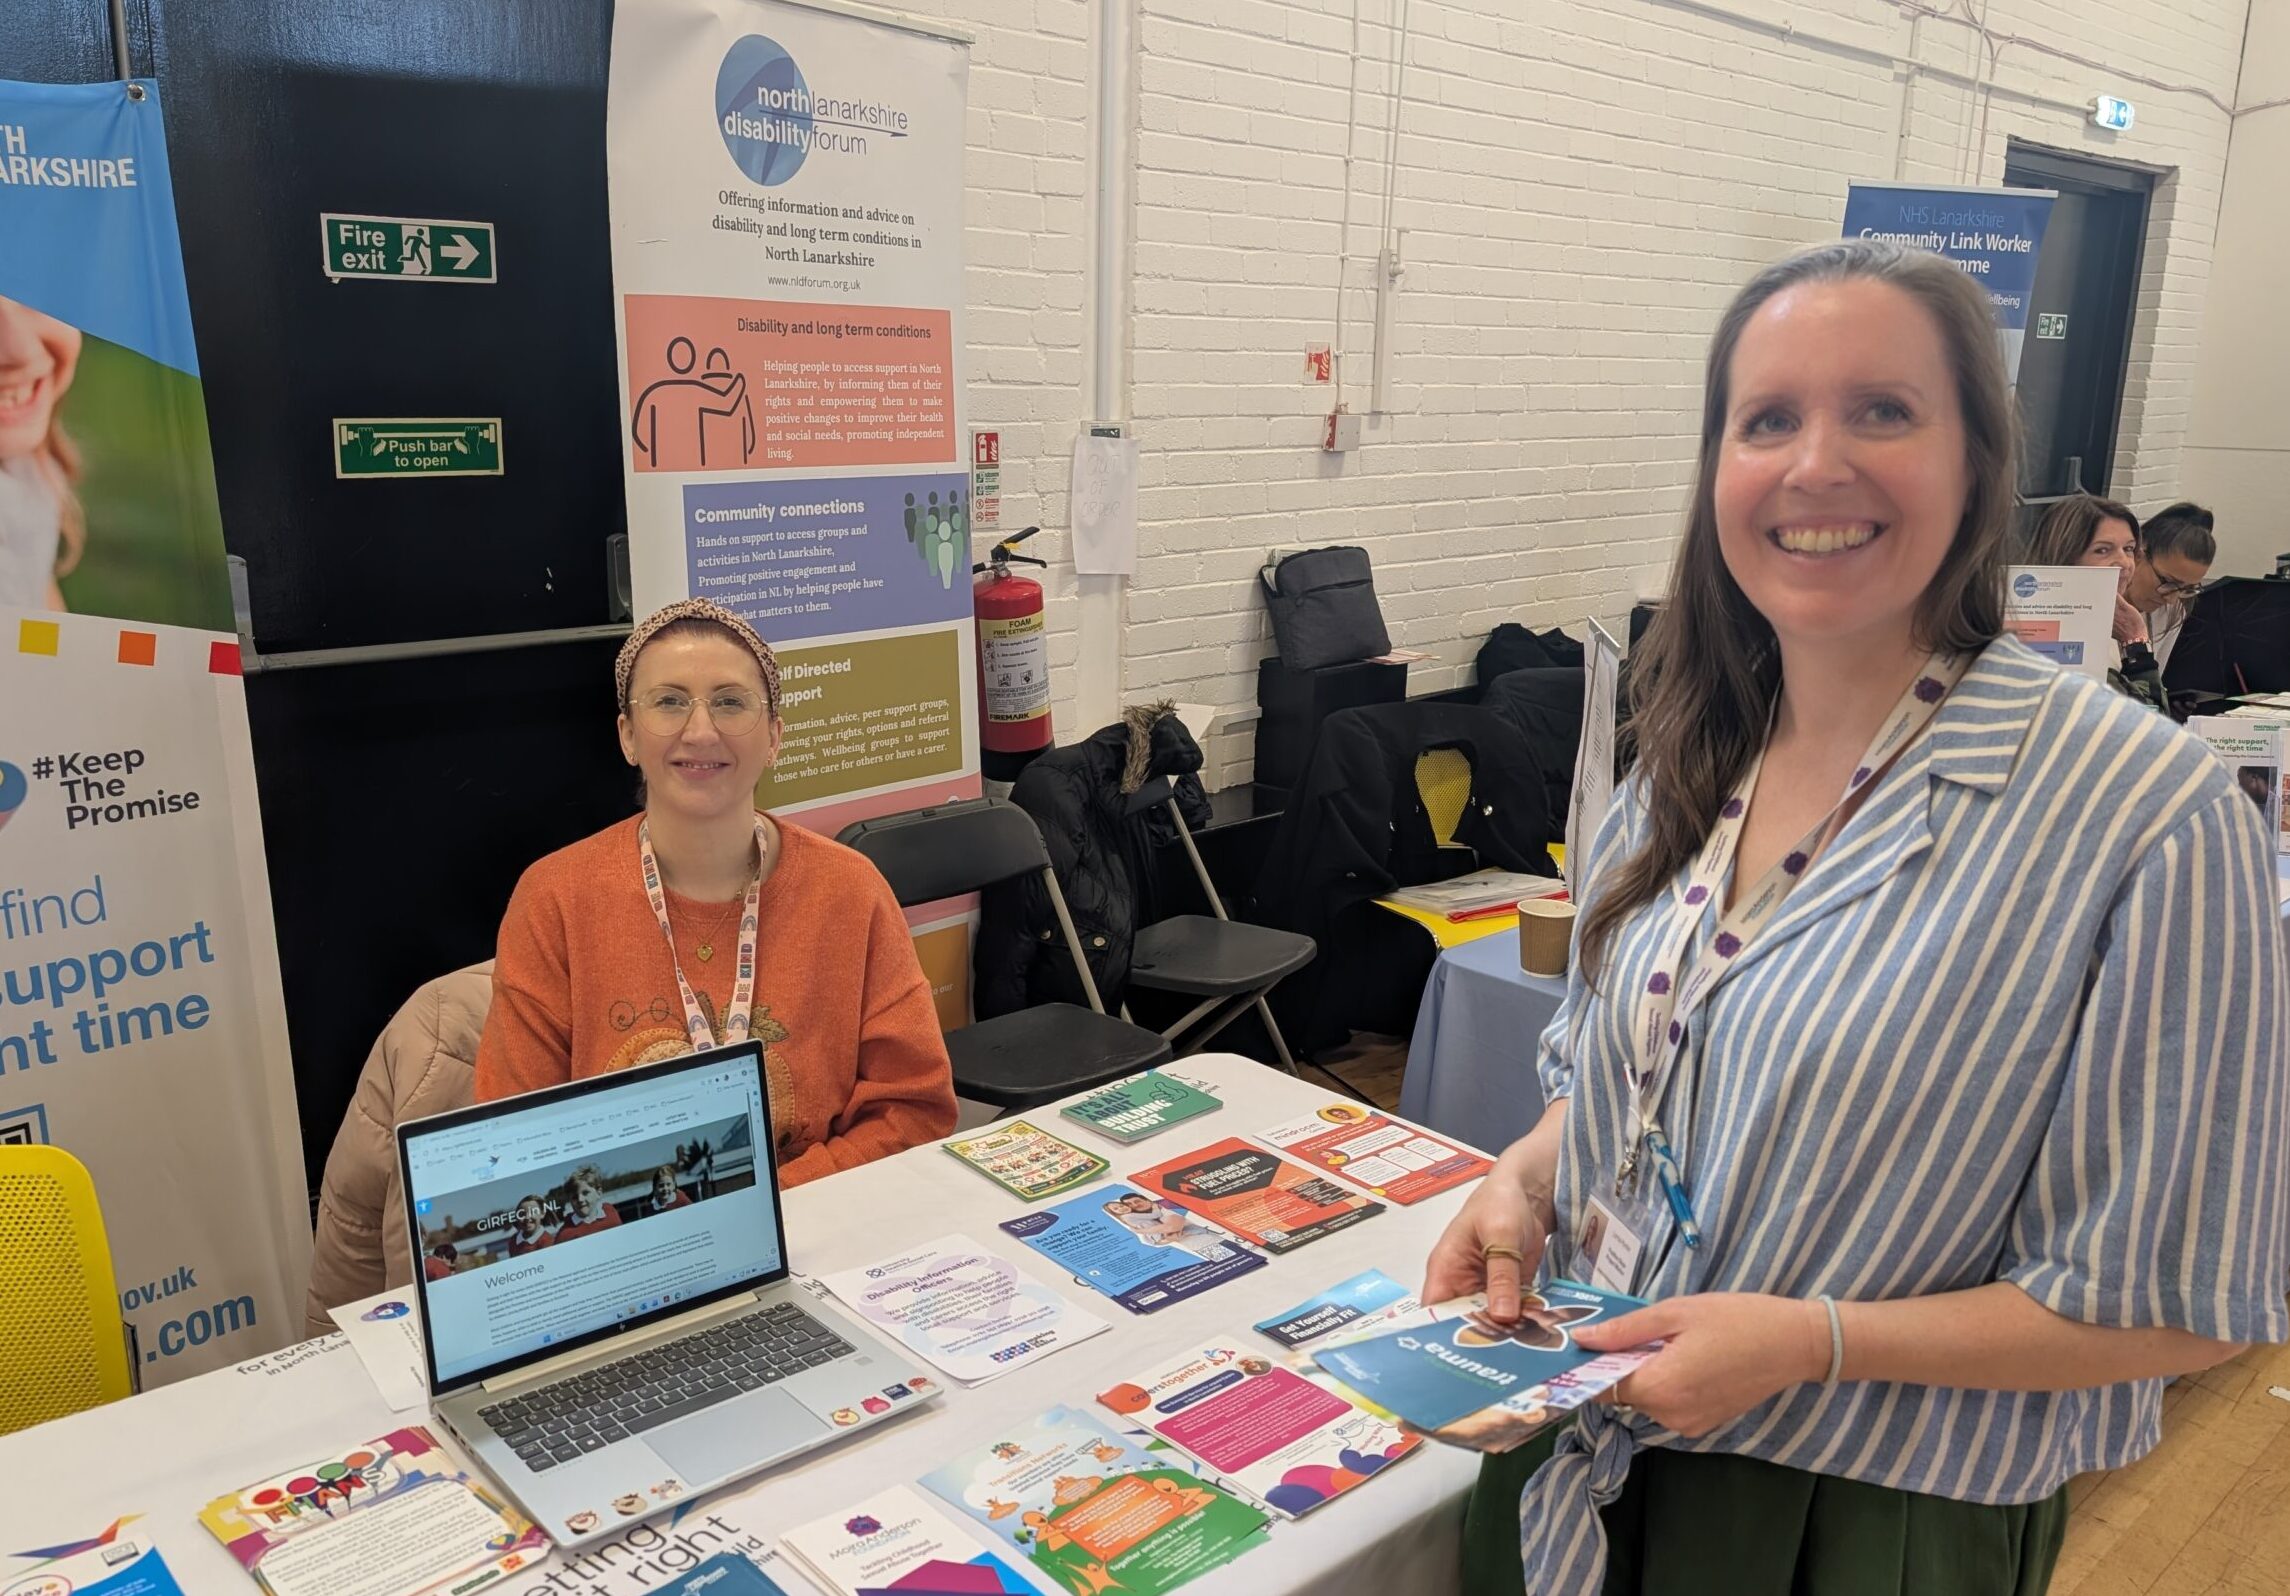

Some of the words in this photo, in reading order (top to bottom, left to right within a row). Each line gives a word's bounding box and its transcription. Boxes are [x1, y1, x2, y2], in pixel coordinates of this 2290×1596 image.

[0, 125, 27, 155] H
[719, 190, 765, 213] Offering
[767, 197, 838, 218] information
[842, 205, 863, 220] and
[866, 208, 899, 224] advice
[902, 214, 914, 225] on
[1900, 206, 1929, 225] NHS
[1932, 208, 2004, 228] Lanarkshire
[339, 224, 385, 246] Fire
[712, 215, 763, 238] disability
[766, 223, 787, 238] and
[790, 223, 816, 243] long
[820, 229, 849, 242] term
[852, 230, 909, 248] conditions
[911, 236, 922, 249] in
[1860, 228, 1947, 251] Community
[1950, 232, 1982, 249] Link
[1985, 233, 2031, 253] Worker
[342, 250, 386, 270] exit
[765, 246, 799, 262] North
[803, 249, 875, 267] Lanarkshire
[768, 276, 861, 292] www.nldforum.org.uk
[738, 318, 788, 338] Disability
[791, 321, 813, 335] and
[816, 322, 842, 339] long
[845, 322, 873, 337] term
[876, 323, 931, 338] conditions
[764, 361, 798, 374] Helping
[800, 362, 828, 375] people
[832, 364, 842, 373] to
[844, 364, 873, 373] access
[875, 363, 907, 376] support
[909, 363, 917, 372] in
[919, 363, 941, 374] North
[764, 378, 820, 392] Lanarkshire,
[824, 380, 834, 392] by
[839, 378, 884, 392] informing
[888, 379, 909, 390] them
[912, 379, 921, 390] of
[923, 380, 942, 390] their
[389, 440, 425, 453] Push
[429, 440, 453, 452] bar
[767, 431, 782, 441] and
[786, 430, 811, 441] social
[815, 430, 843, 442] needs,
[847, 428, 893, 443] promoting
[896, 428, 944, 441] independent
[395, 456, 408, 467] to
[413, 456, 449, 469] open
[767, 447, 794, 461] living.
[695, 503, 775, 524] Community
[780, 500, 865, 517] connections
[696, 535, 726, 549] Hands
[729, 535, 740, 545] on
[742, 531, 773, 546] support
[776, 531, 785, 541] to
[788, 529, 816, 540] access
[818, 527, 849, 541] groups
[851, 524, 868, 536] and
[697, 553, 740, 568] activities
[742, 553, 749, 563] in
[752, 550, 777, 562] North
[779, 546, 834, 561] Lanarkshire,
[698, 571, 747, 588] Promoting
[749, 568, 781, 585] positive
[783, 564, 837, 581] engagement
[839, 561, 856, 573] and
[1009, 618, 1031, 628] FOAM
[778, 666, 792, 681] elf
[795, 658, 851, 677] Directed
[779, 686, 823, 707] upport
[773, 753, 816, 769] pathways.
[823, 742, 866, 757] Wellbeing
[871, 738, 899, 751] groups
[905, 733, 913, 742] to
[919, 727, 950, 741] support
[32, 749, 145, 780] #Keep
[774, 772, 798, 783] those
[800, 767, 818, 777] who
[821, 764, 839, 774] care
[841, 759, 854, 769] for
[856, 756, 883, 767] others
[896, 749, 916, 758] have
[924, 744, 947, 754] carer.
[60, 778, 125, 803] The
[66, 790, 200, 830] Promise
[0, 874, 107, 940] find
[0, 921, 214, 1009] upport
[73, 994, 210, 1054] time
[1071, 1099, 1104, 1116] IT'S
[1101, 1090, 1131, 1110] ALL
[1088, 1101, 1139, 1122] ABOUT
[1096, 1100, 1173, 1128] BUILDING
[1112, 1114, 1167, 1133] TRUST
[1189, 1164, 1239, 1188] STRUGGLING
[1233, 1156, 1260, 1173] WITH
[1198, 1176, 1227, 1191] FUEL
[1222, 1166, 1254, 1186] PRICES?
[476, 1208, 526, 1231] GIRFEC
[528, 1206, 541, 1217] in
[543, 1200, 561, 1212] NL
[124, 1266, 197, 1310] ov.uk
[484, 1262, 545, 1290] Welcome
[867, 1274, 921, 1301] Disability
[916, 1256, 980, 1286] Information
[912, 1276, 954, 1294] Officers
[1279, 1320, 1299, 1337] Get
[1296, 1306, 1337, 1331] Yourself
[1291, 1314, 1343, 1343] Financially
[1339, 1308, 1358, 1324] Fit
[236, 1359, 269, 1375] for
[281, 1350, 320, 1371] North
[1423, 1341, 1518, 1387] trauma
[864, 1518, 922, 1545] Anderson
[522, 1520, 668, 1596] etting
[626, 1514, 742, 1587] right
[1109, 1549, 1143, 1573] Together
